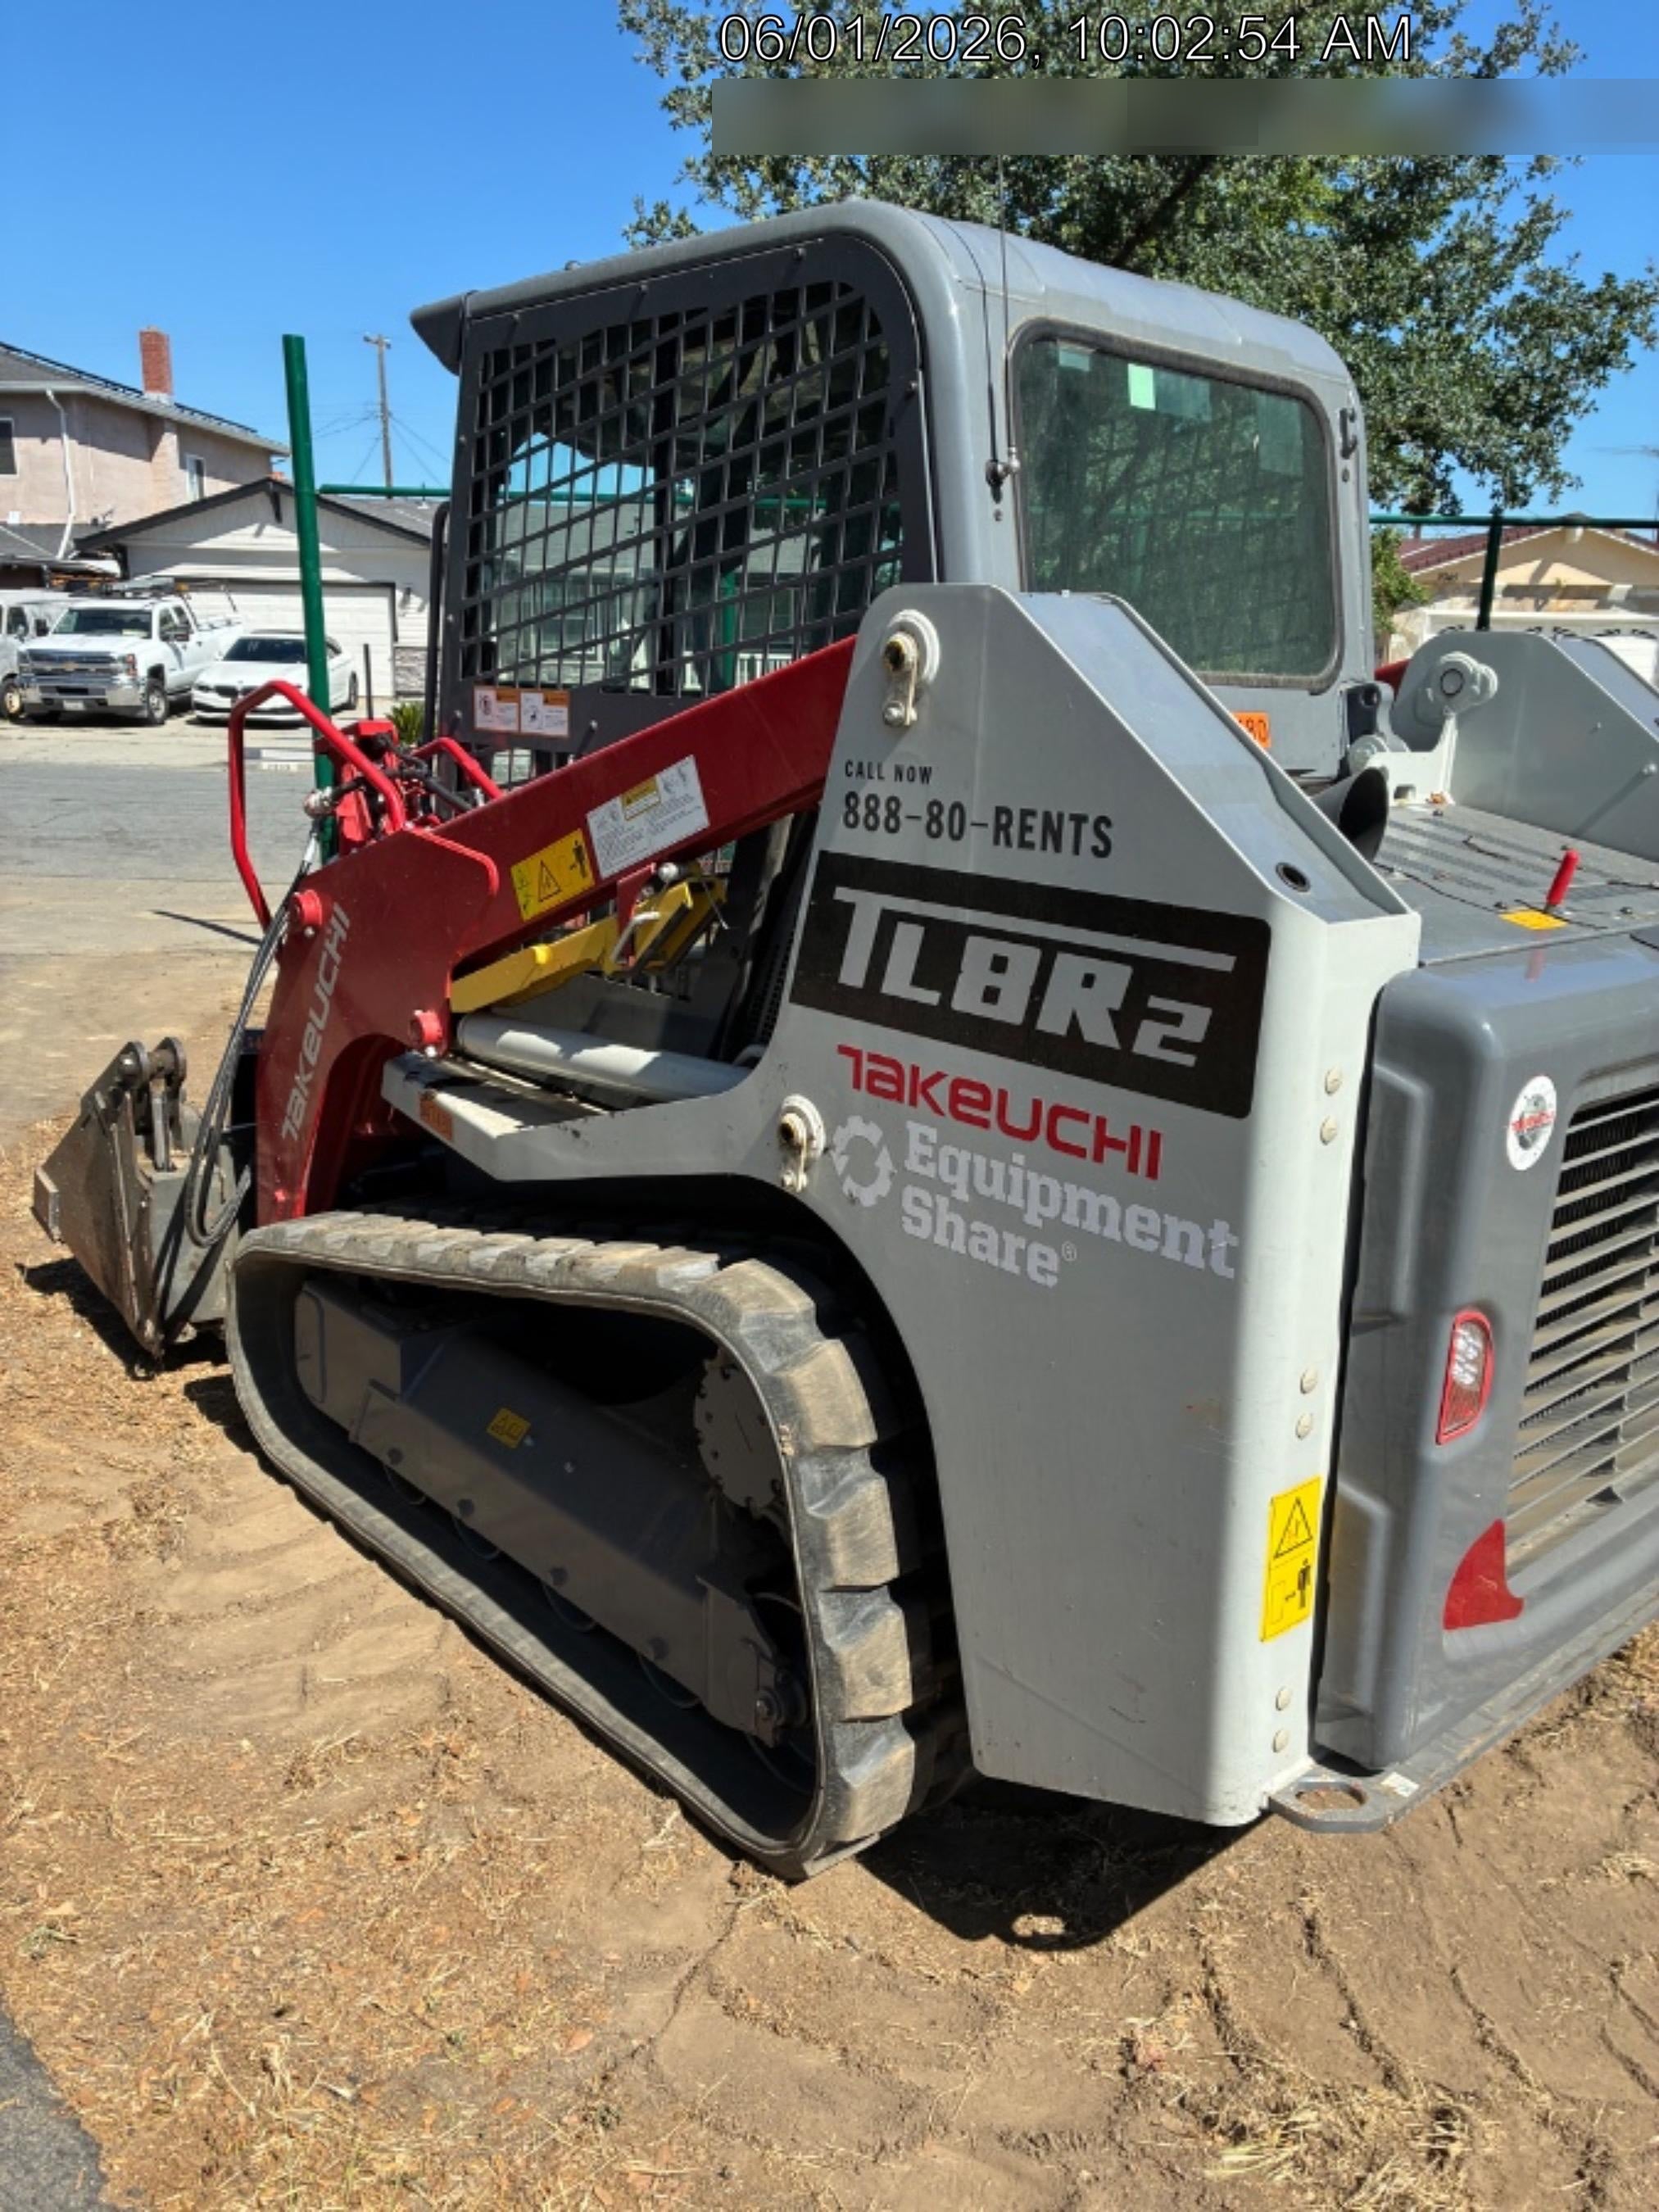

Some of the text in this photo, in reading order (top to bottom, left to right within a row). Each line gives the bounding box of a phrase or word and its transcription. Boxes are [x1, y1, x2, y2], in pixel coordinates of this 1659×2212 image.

[842, 791, 1113, 859] 888-80-RENTS
[845, 760, 932, 785] CALL NOW
[833, 886, 1237, 1067] TL8R2
[904, 1120, 1240, 1280] Equipment
